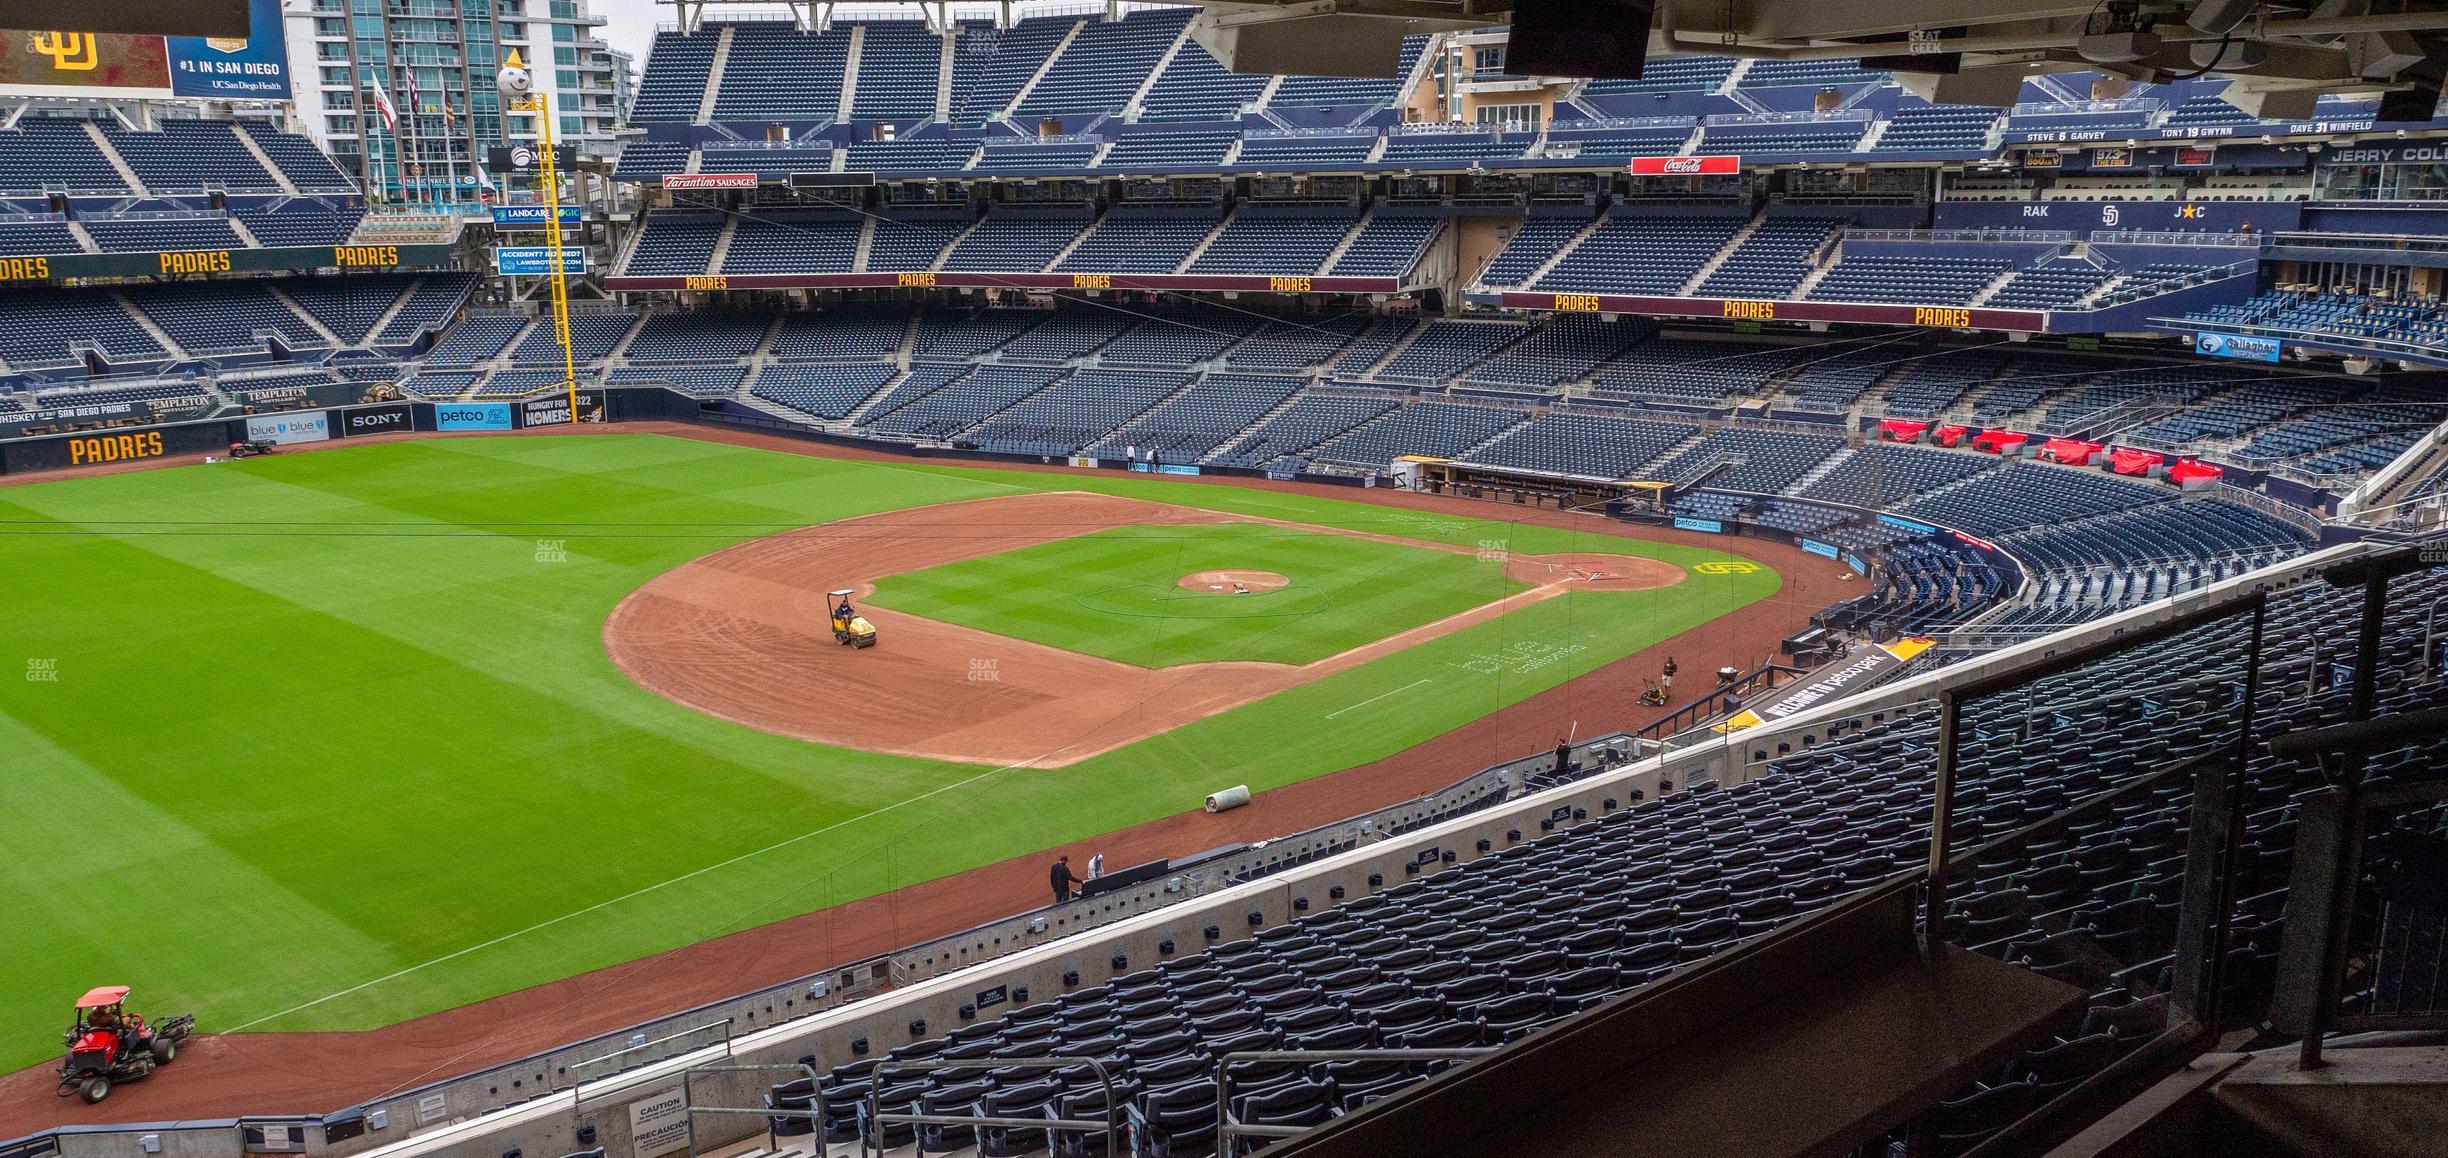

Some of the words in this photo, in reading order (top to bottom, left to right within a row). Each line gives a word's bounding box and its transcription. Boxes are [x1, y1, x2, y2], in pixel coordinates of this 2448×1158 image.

[180, 61, 195, 72] #1
[200, 61, 213, 73] IN
[216, 62, 241, 74] SAN
[244, 63, 279, 75] DIEGO
[212, 80, 224, 89] UC
[224, 80, 239, 89] San
[239, 81, 259, 91] Diego
[259, 82, 282, 90] Health
[2161, 129, 2183, 138] TONY
[2187, 127, 2198, 137] 19
[2200, 127, 2233, 136] GWYNN
[2290, 124, 2313, 133] DAVE
[2315, 123, 2327, 133] 31
[2329, 122, 2372, 131] WINFIELD
[2027, 133, 2054, 141] STEVE
[2058, 132, 2066, 141] 6
[2070, 131, 2106, 140] GARVEY
[2332, 149, 2394, 162] JERRY
[665, 176, 716, 188] Tarantino
[716, 178, 756, 187] SAUSAGES
[508, 209, 551, 218] LANDCARE
[2023, 206, 2049, 217] RAK
[159, 250, 231, 274] PADRES
[335, 245, 398, 266] PADRES
[686, 276, 727, 290] PADRES
[898, 272, 936, 287] PADRES
[1073, 275, 1111, 289] PADRES
[1270, 277, 1311, 292] PADRES
[1555, 294, 1599, 312] PADRES
[1723, 301, 1774, 319] PADRES
[1915, 307, 1969, 327] PADRES
[2225, 338, 2277, 354] Gallagher
[247, 388, 307, 401] TEMPLETON
[575, 396, 592, 406] 322
[147, 396, 209, 411] TEMPLETON
[527, 401, 554, 410] HUNGRY
[555, 399, 567, 408] FOR
[58, 408, 75, 418] SAN
[76, 406, 99, 416] DIEGO
[101, 404, 131, 414] PADRES
[440, 407, 485, 424] petco
[525, 408, 572, 426] HOMERS
[352, 412, 403, 427] SONY
[250, 425, 276, 435] blue
[289, 421, 314, 431] blue
[69, 431, 164, 465] PADRES
[1676, 519, 1697, 527] petco
[1804, 541, 1820, 550] petco
[1764, 689, 1823, 717] WELCOME
[640, 1097, 680, 1115] CAUTION
